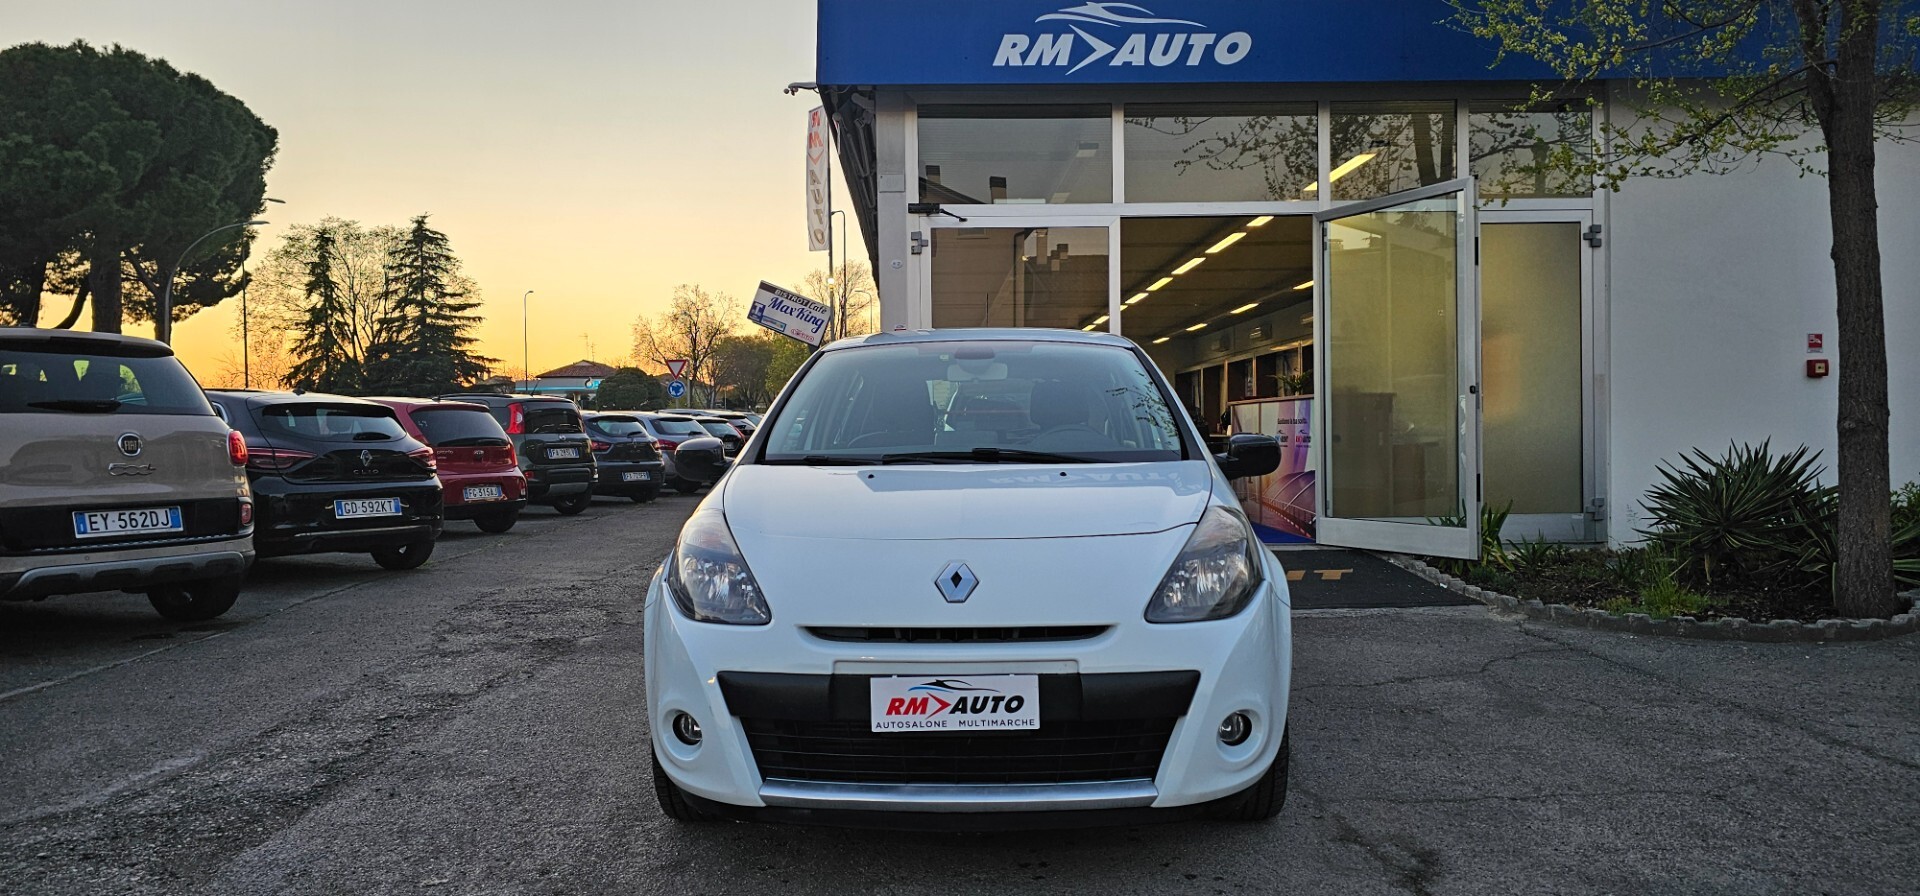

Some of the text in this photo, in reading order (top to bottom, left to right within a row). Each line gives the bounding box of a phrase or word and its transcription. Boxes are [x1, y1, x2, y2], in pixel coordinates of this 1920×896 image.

[1108, 31, 1253, 67] AUTO
[775, 289, 809, 307] BISTROT
[948, 695, 1025, 715] AUTO
[875, 719, 1035, 729] AUTOSALONE MULTIMARCHE
